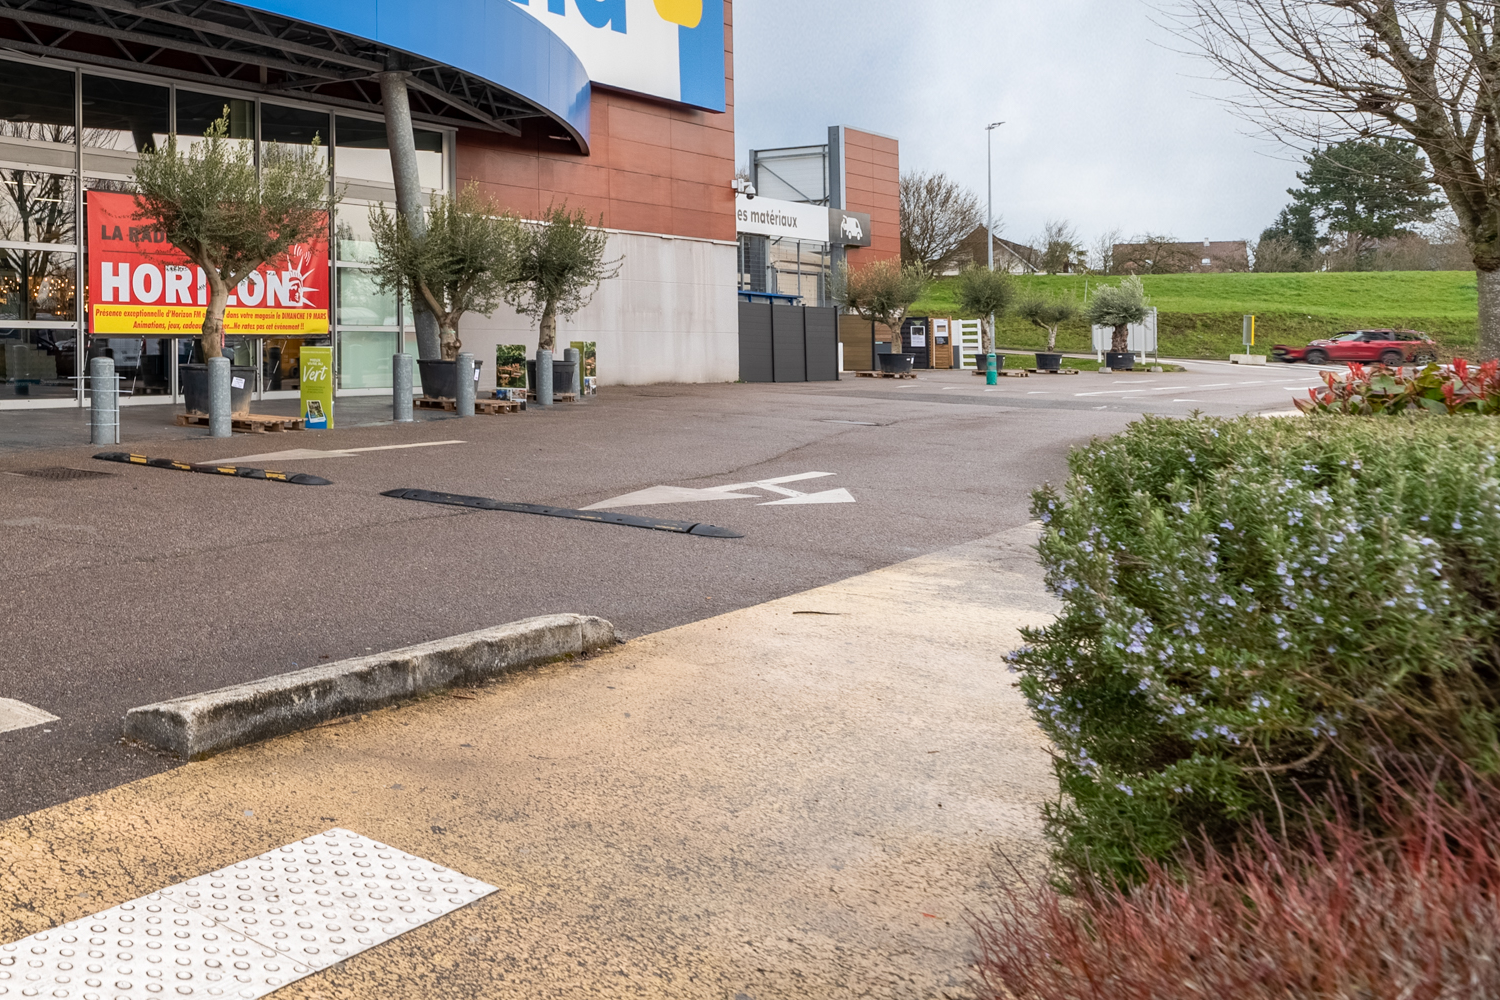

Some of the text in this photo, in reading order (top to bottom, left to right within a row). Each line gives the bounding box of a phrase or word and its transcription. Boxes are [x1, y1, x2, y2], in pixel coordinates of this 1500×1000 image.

[737, 208, 798, 228] es matériaux
[101, 224, 171, 244] LA RAD
[95, 308, 122, 317] Présence
[124, 309, 164, 318] exceptionnelle
[166, 310, 192, 318] d'Horizon
[193, 310, 201, 318] FM
[226, 311, 239, 319] dans
[255, 312, 275, 320] magasin
[281, 312, 305, 320] DIMANCHE
[133, 321, 167, 330] Animations,
[168, 321, 181, 330] jeux,
[182, 321, 203, 330] cadeau
[302, 365, 329, 382] Vert
